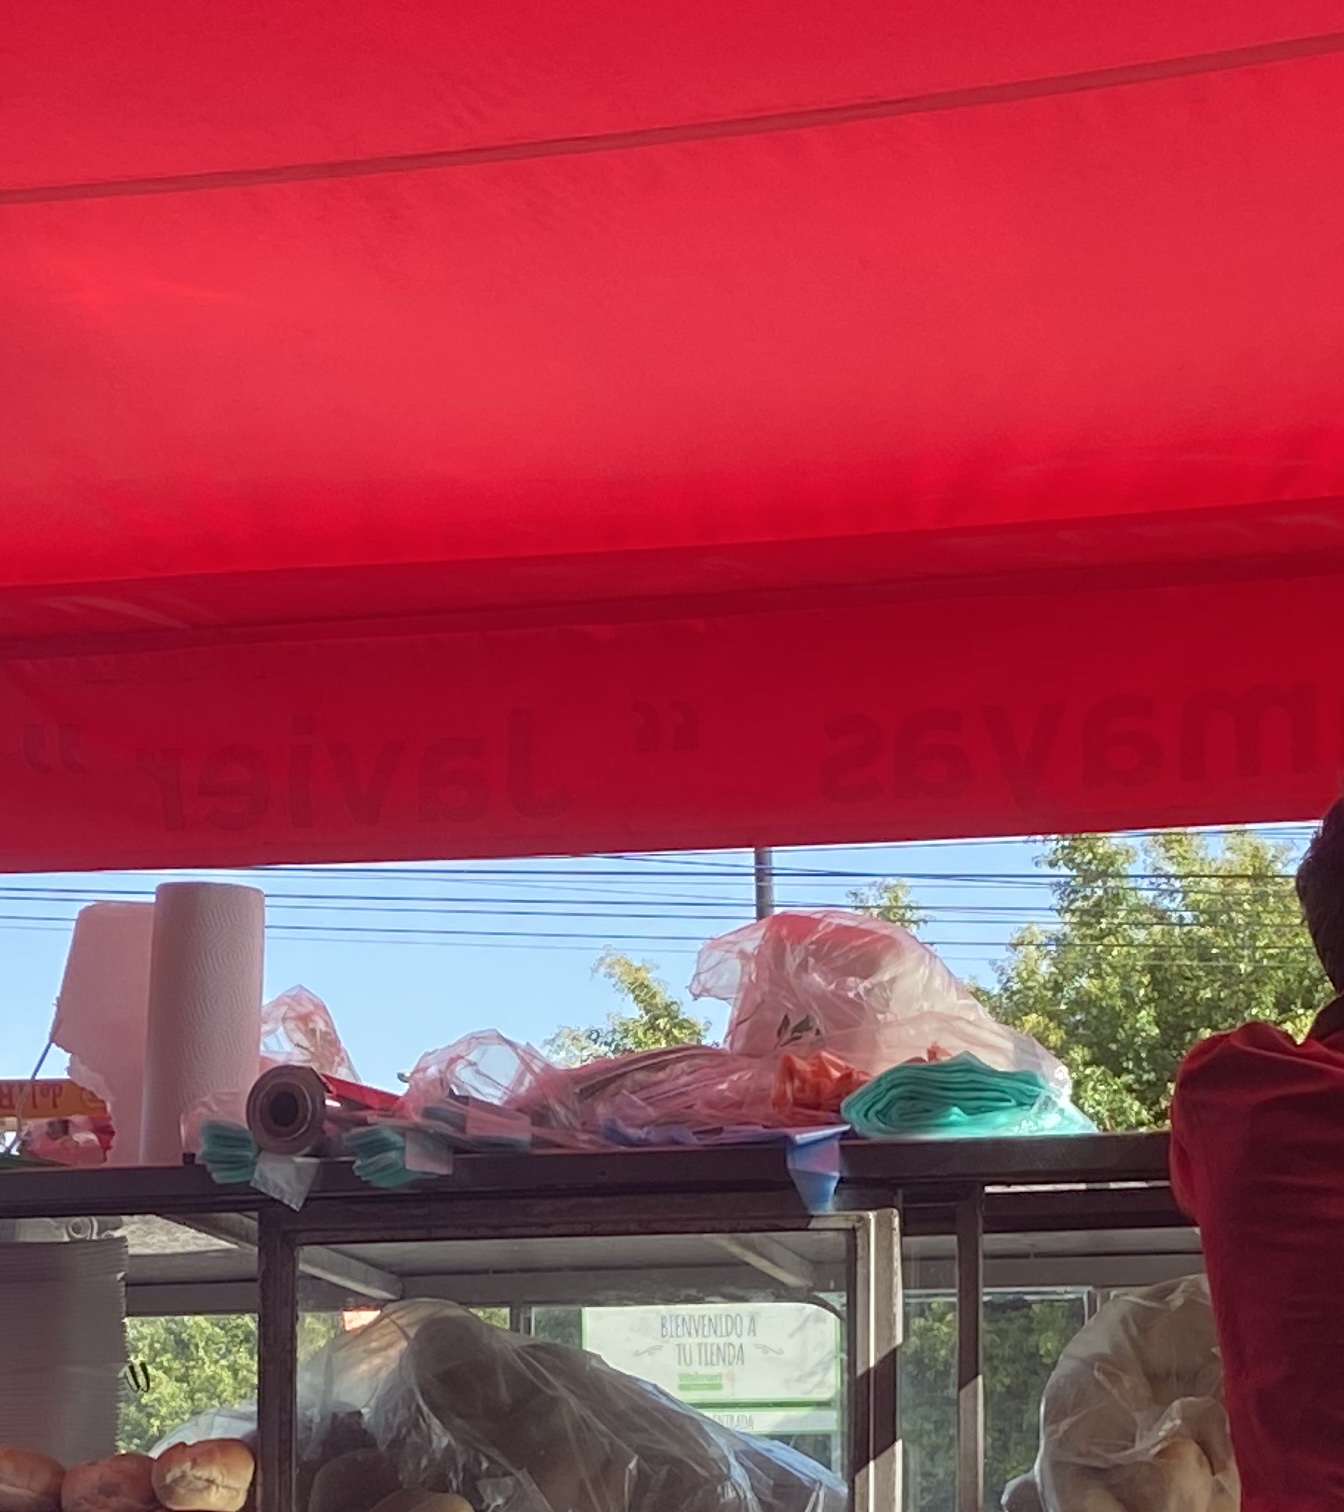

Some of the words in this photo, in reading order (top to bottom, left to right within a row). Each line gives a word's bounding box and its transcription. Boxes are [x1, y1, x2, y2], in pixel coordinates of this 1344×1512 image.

[660, 1313, 744, 1339] BIENVENIDO
[747, 1314, 757, 1338] A
[676, 1342, 693, 1367] TU
[696, 1342, 745, 1367] TIENDA
